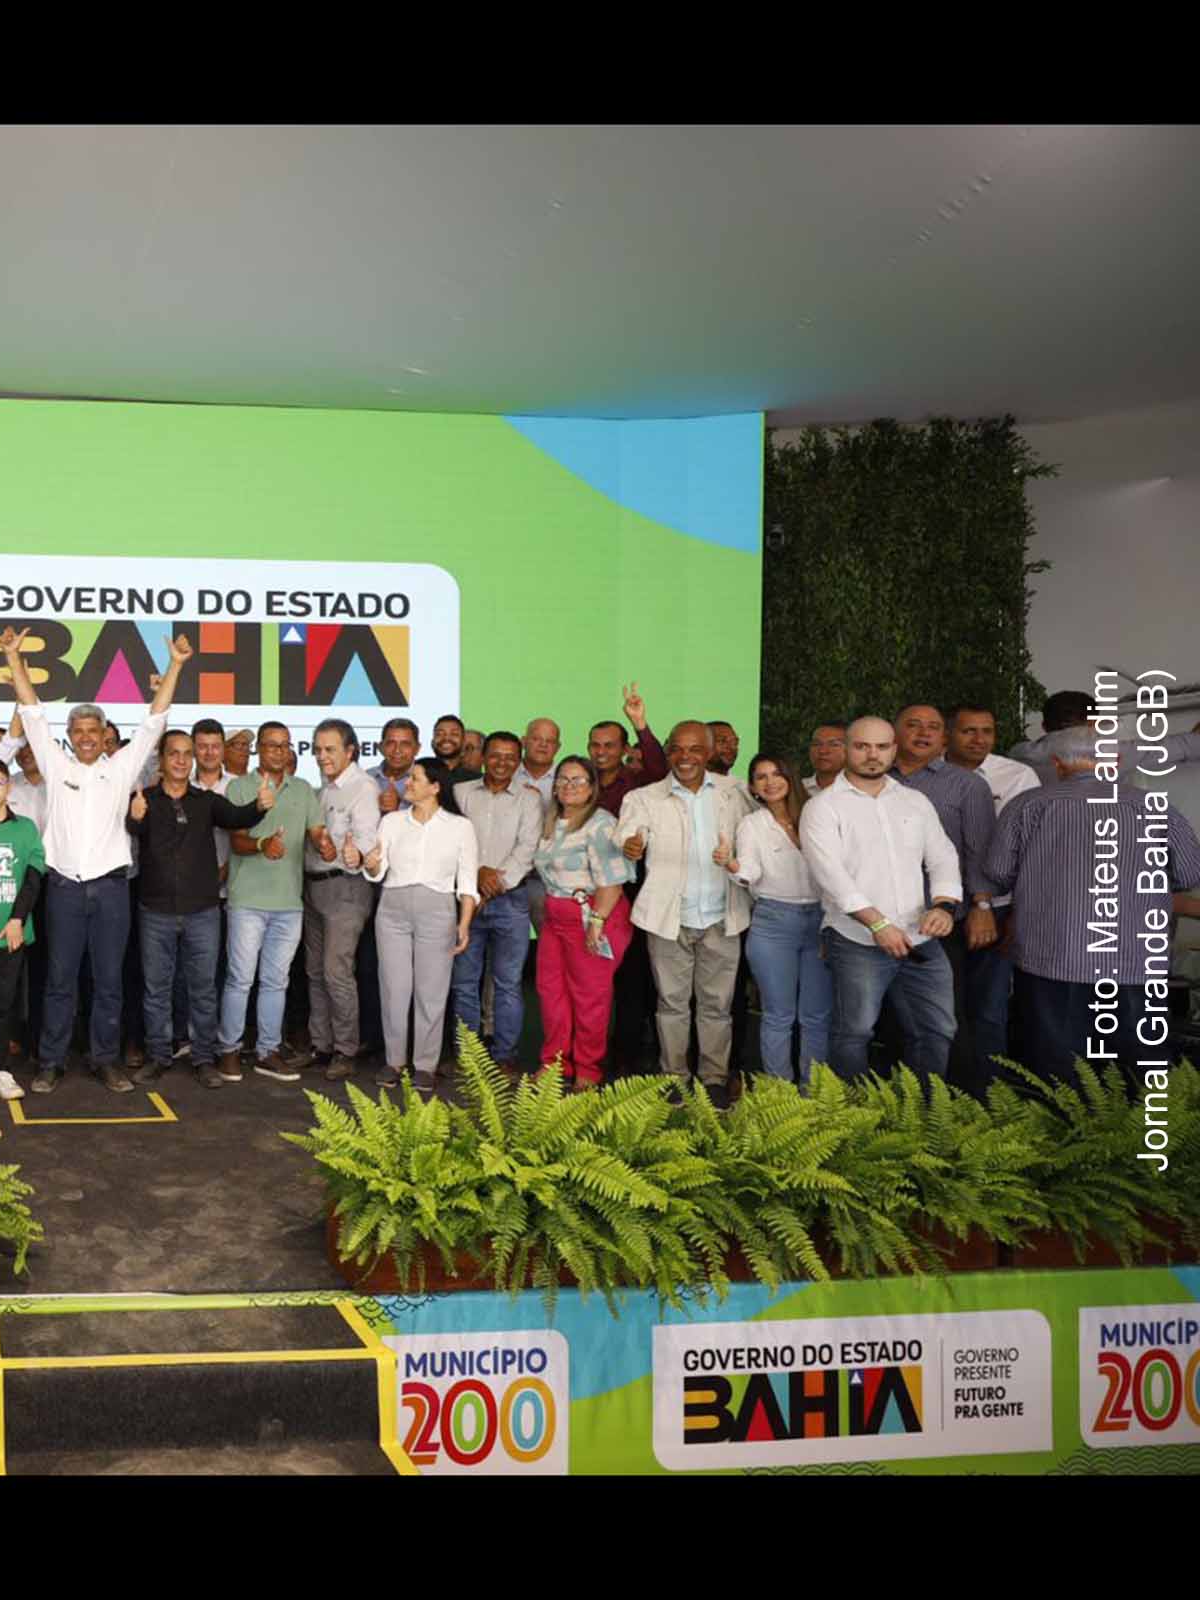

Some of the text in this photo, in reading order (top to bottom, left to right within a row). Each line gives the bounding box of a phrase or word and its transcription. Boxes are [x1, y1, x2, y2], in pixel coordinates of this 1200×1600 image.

[197, 588, 253, 616] DO
[265, 590, 411, 619] ESTADO
[1100, 1317, 1200, 1347] MUNICÍP
[405, 1347, 547, 1378] MUNICÍPIO
[684, 1340, 922, 1371] GOVERNO DO ESTADO
[954, 1348, 1019, 1364] GOVERNO
[954, 1364, 1012, 1380] PRESENTE
[684, 1366, 922, 1444] BAHIA
[954, 1386, 1006, 1402] FUTURO
[402, 1377, 556, 1465] 200
[954, 1402, 1024, 1419] PRA GENTE
